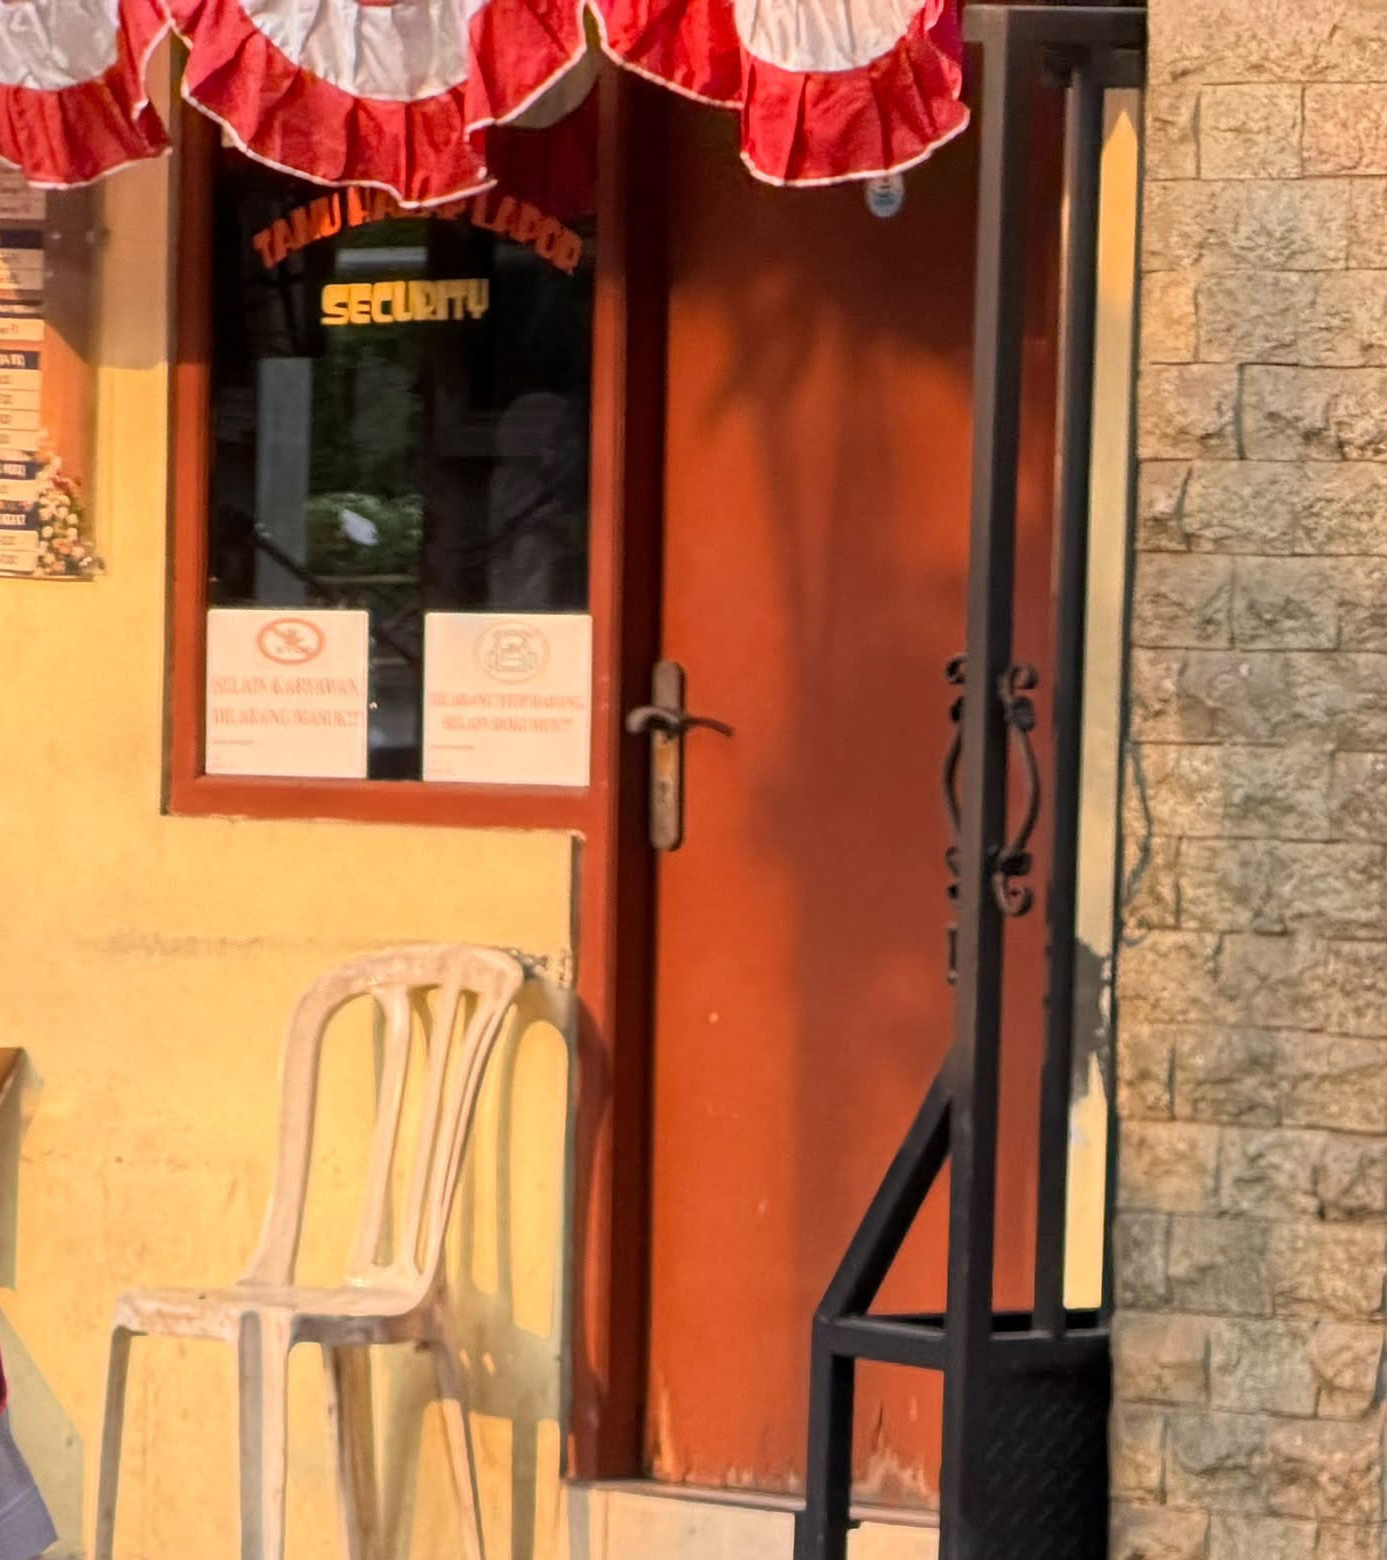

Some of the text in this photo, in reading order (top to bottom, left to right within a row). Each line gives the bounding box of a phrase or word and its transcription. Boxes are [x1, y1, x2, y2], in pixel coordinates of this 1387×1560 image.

[252, 190, 342, 270] TAMU
[470, 190, 583, 277] LAPOR
[320, 277, 490, 326] SECURITY
